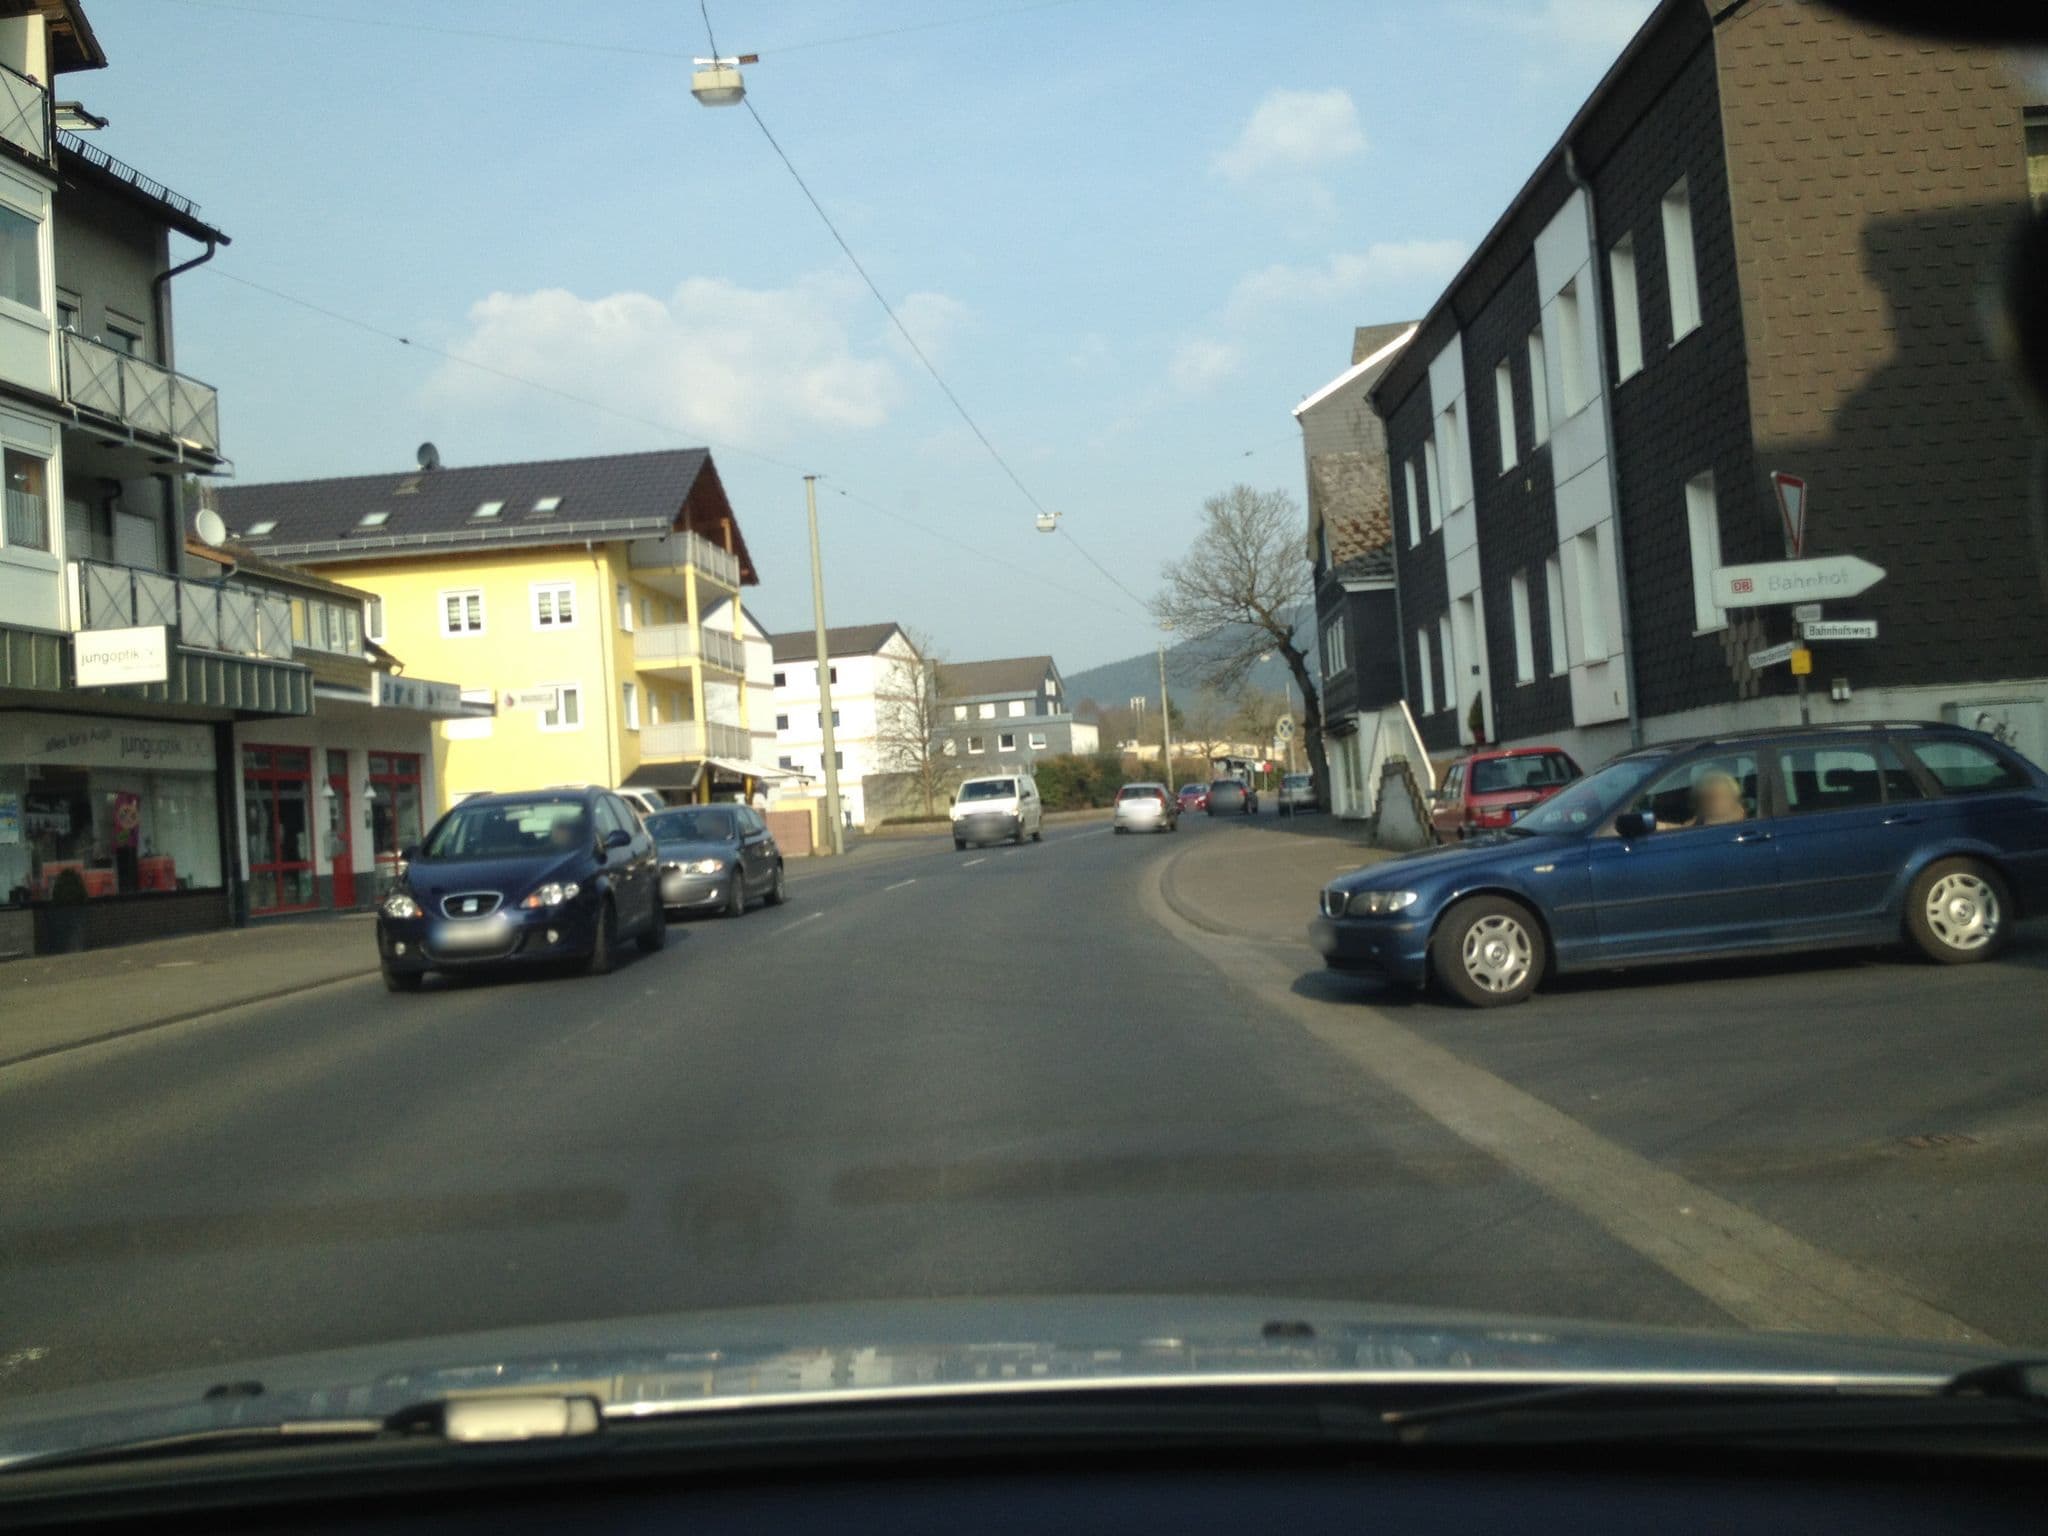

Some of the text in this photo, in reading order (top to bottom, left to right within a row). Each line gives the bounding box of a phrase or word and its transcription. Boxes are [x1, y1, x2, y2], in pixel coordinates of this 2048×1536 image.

[1733, 569, 1848, 592] DB Bahnhof
[1808, 625, 1872, 637] Bahnhofsweg
[81, 648, 140, 667] jungoptik
